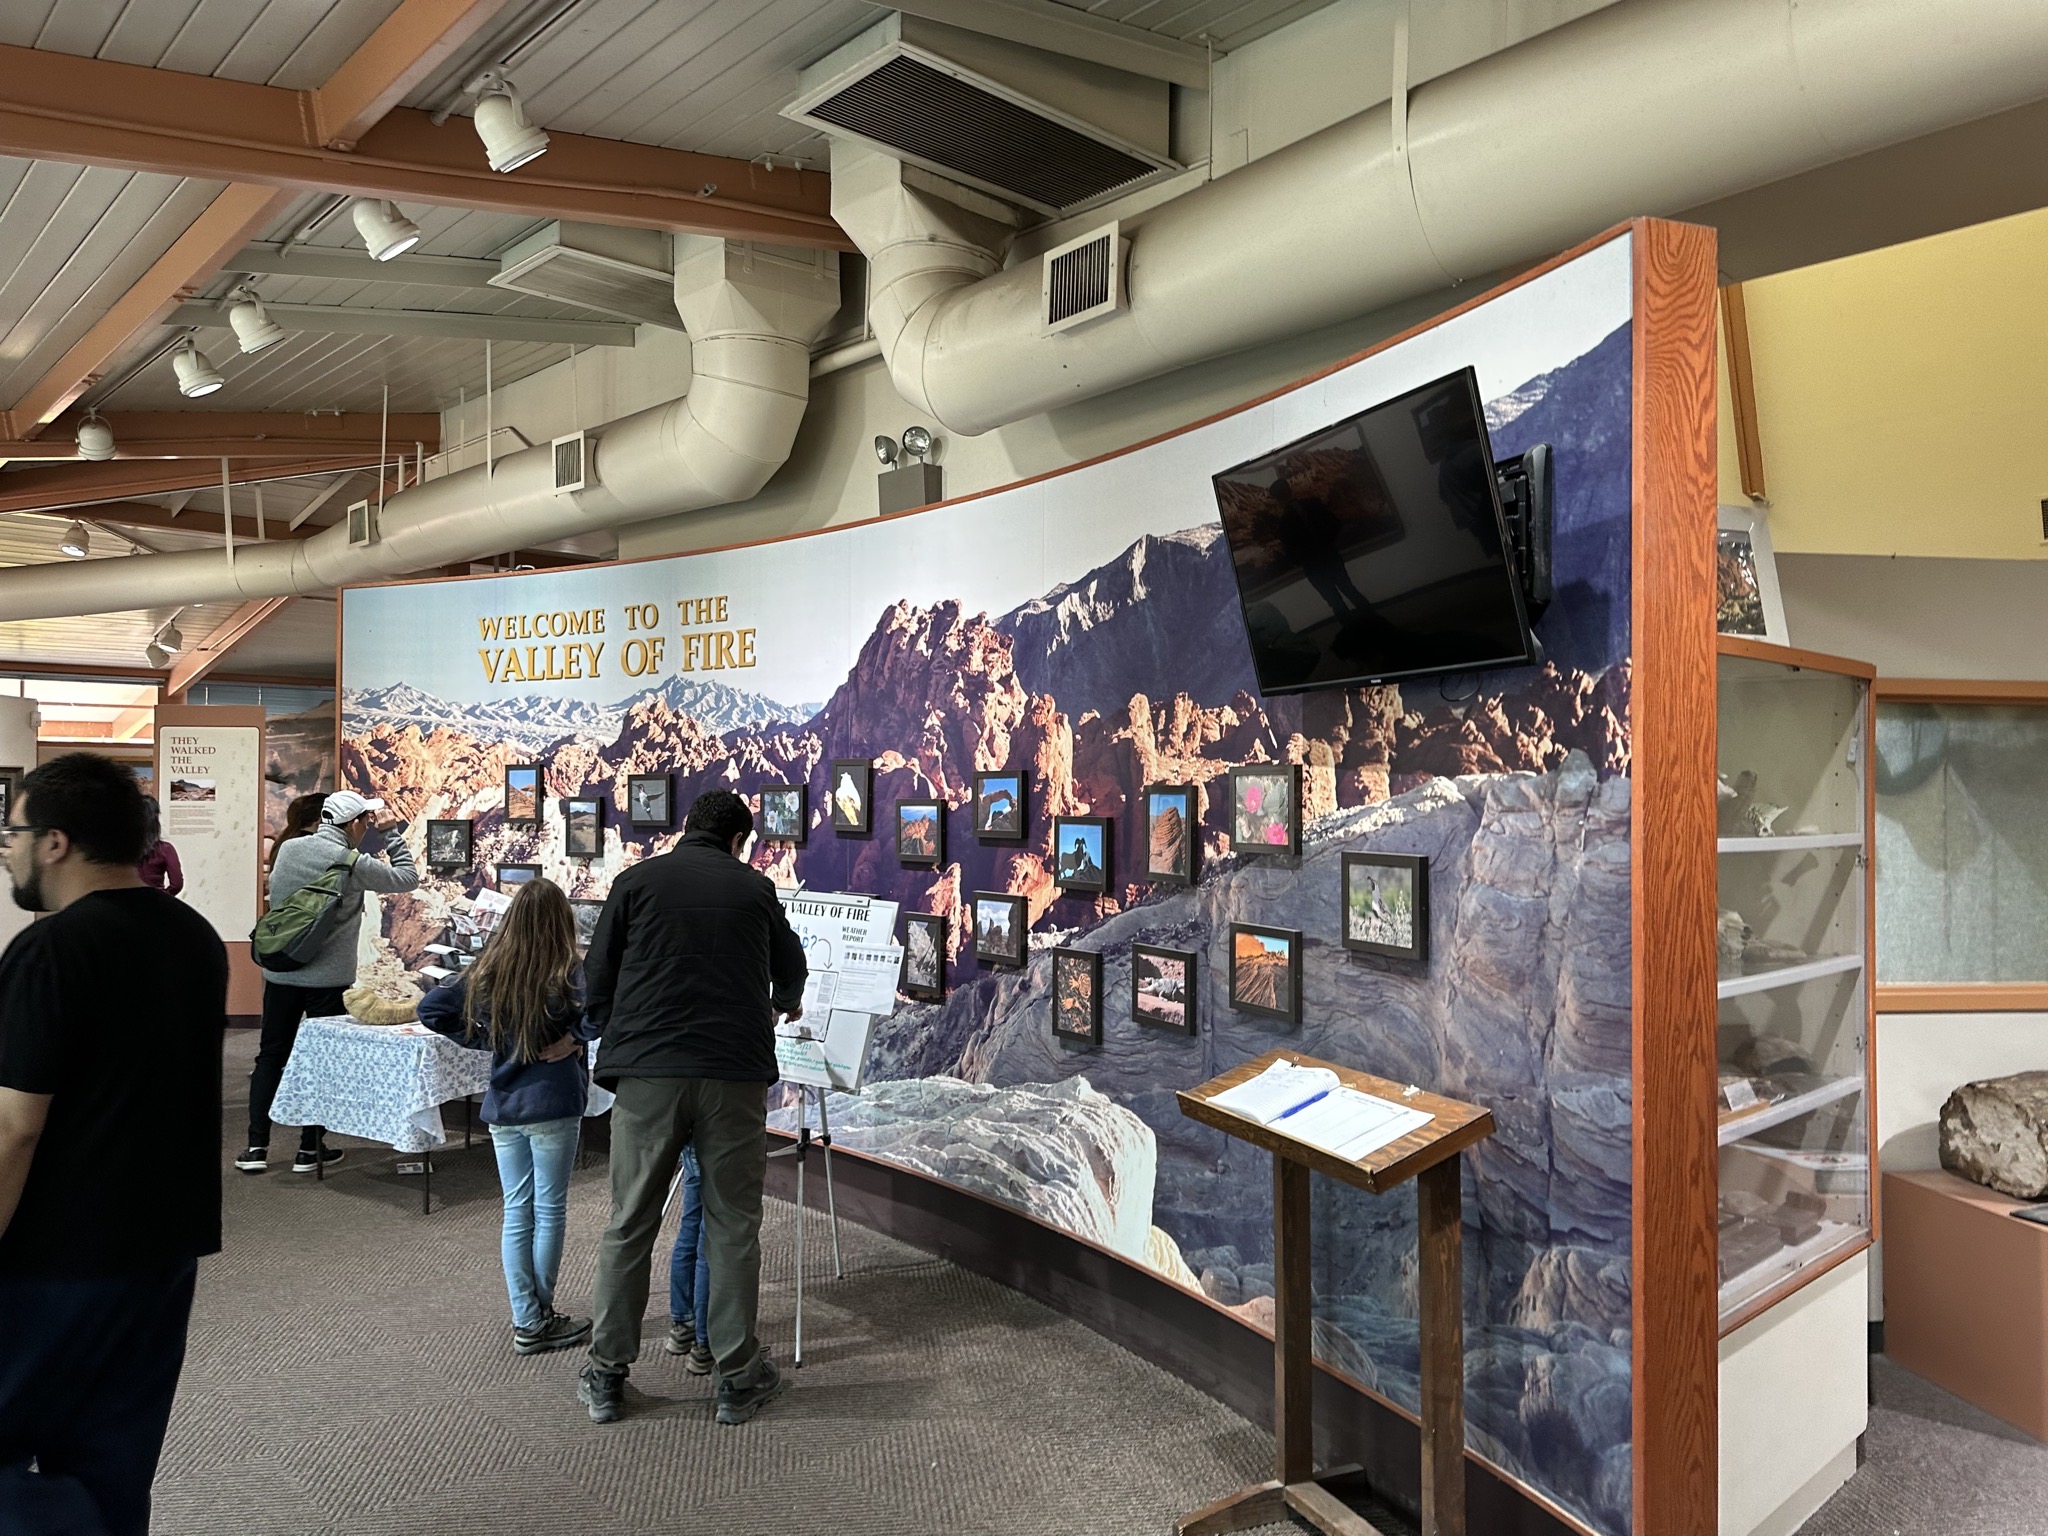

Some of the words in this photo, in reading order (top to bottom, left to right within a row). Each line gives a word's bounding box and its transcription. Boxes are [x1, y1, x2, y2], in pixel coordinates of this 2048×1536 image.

[478, 608, 605, 641] WELCOME
[624, 603, 660, 630] TO
[677, 595, 729, 626] THE
[478, 642, 605, 683] VALLEY
[620, 637, 665, 677] OF
[681, 628, 757, 672] FIRE
[170, 736, 200, 745] THEY
[170, 746, 217, 755] WALKED
[170, 756, 193, 765] THE
[170, 766, 210, 774] VALLEY
[791, 902, 827, 917] VALLEY
[830, 906, 845, 919] OF
[846, 908, 871, 922] FIRE
[842, 926, 868, 936] WEATHER
[842, 934, 864, 943] REPORT
